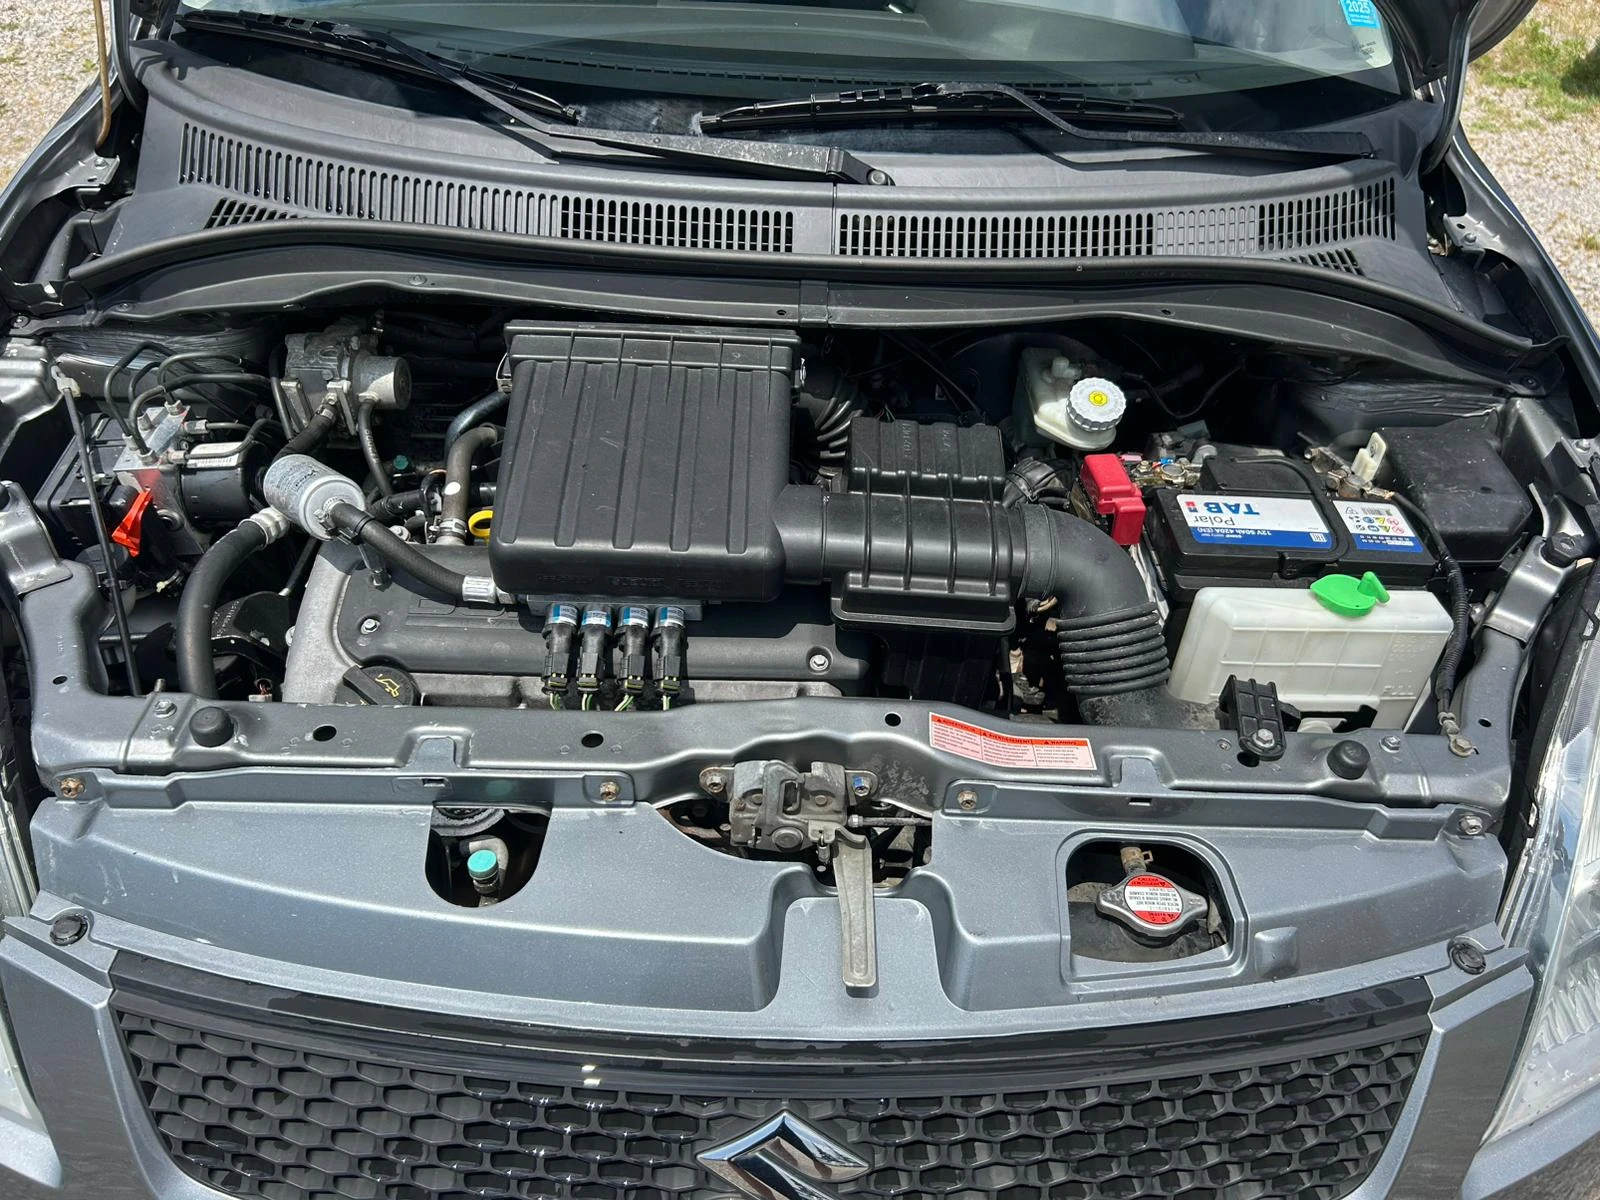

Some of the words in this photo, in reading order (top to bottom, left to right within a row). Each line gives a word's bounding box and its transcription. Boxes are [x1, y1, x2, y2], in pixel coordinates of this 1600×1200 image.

[1348, 1, 1370, 13] 2025
[1203, 502, 1260, 515] TAB
[1194, 515, 1235, 526] Polar
